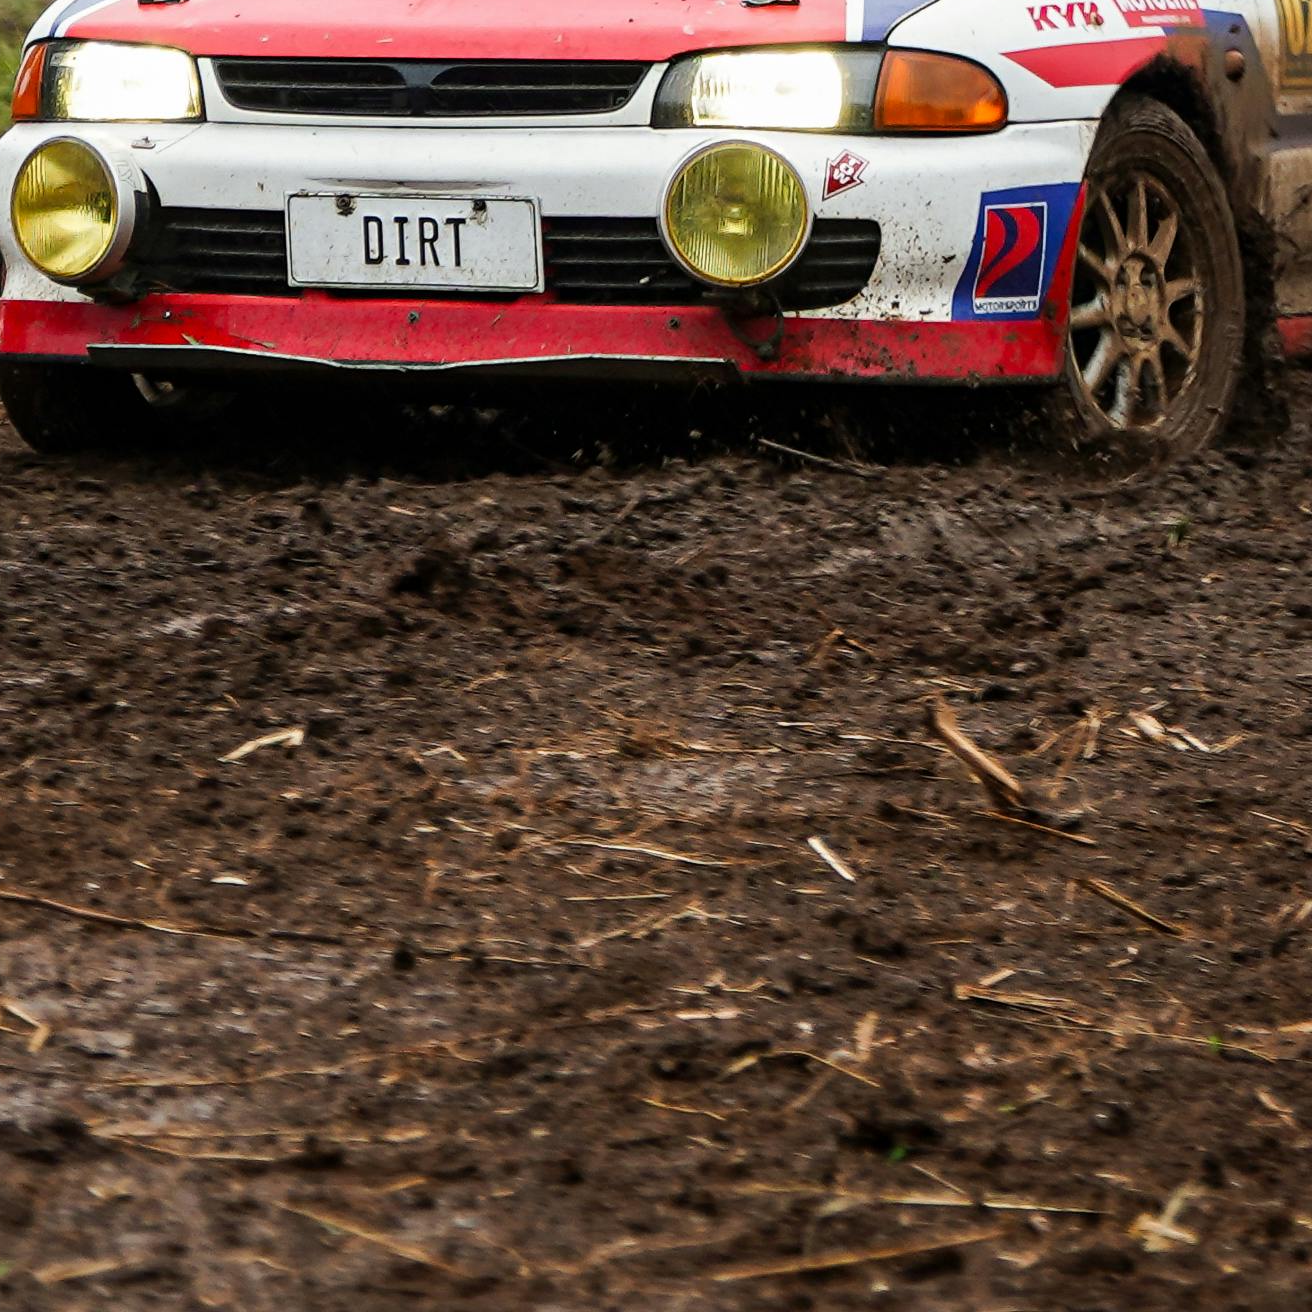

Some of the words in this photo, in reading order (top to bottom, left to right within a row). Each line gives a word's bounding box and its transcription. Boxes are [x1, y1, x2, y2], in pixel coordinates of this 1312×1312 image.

[1026, 1, 1105, 32] KYB
[832, 156, 861, 185] TOW
[362, 215, 467, 268] DIRT
